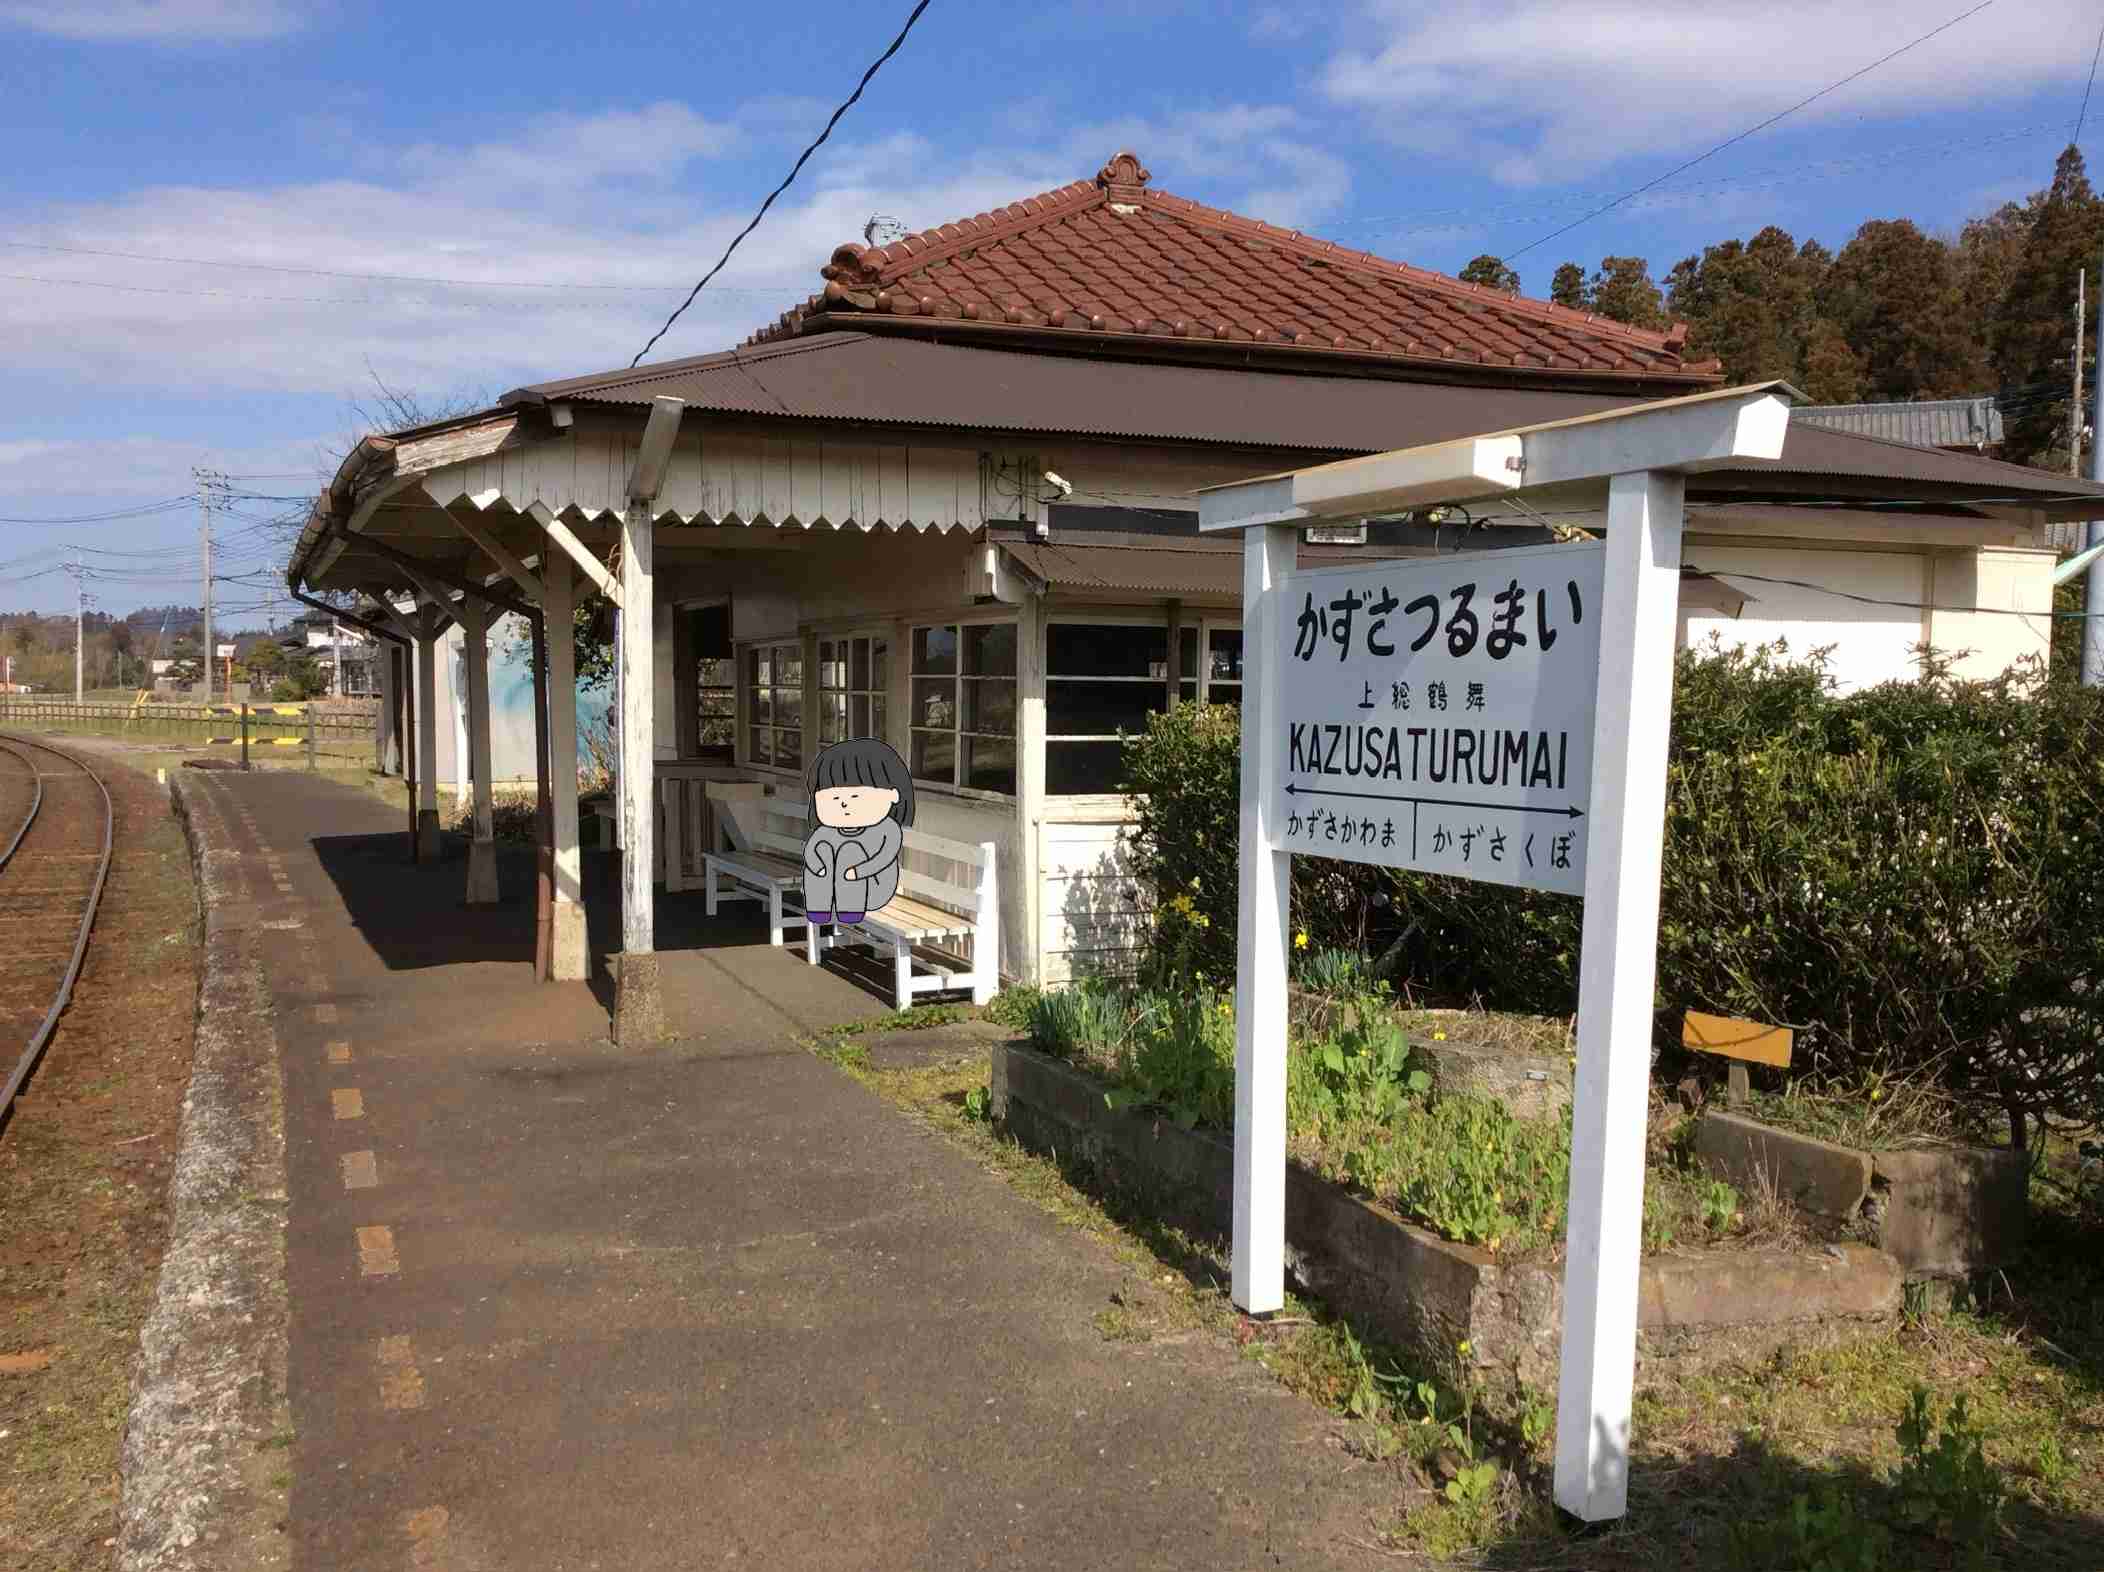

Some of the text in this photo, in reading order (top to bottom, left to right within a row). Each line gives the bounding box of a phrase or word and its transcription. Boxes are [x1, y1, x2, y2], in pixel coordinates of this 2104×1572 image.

[1293, 578, 1583, 663] かずさつるまい
[1289, 722, 1568, 790] KAZUSATURUMAI
[1287, 808, 1396, 849] かずさかわま
[1432, 823, 1577, 870] かずさくぼ
